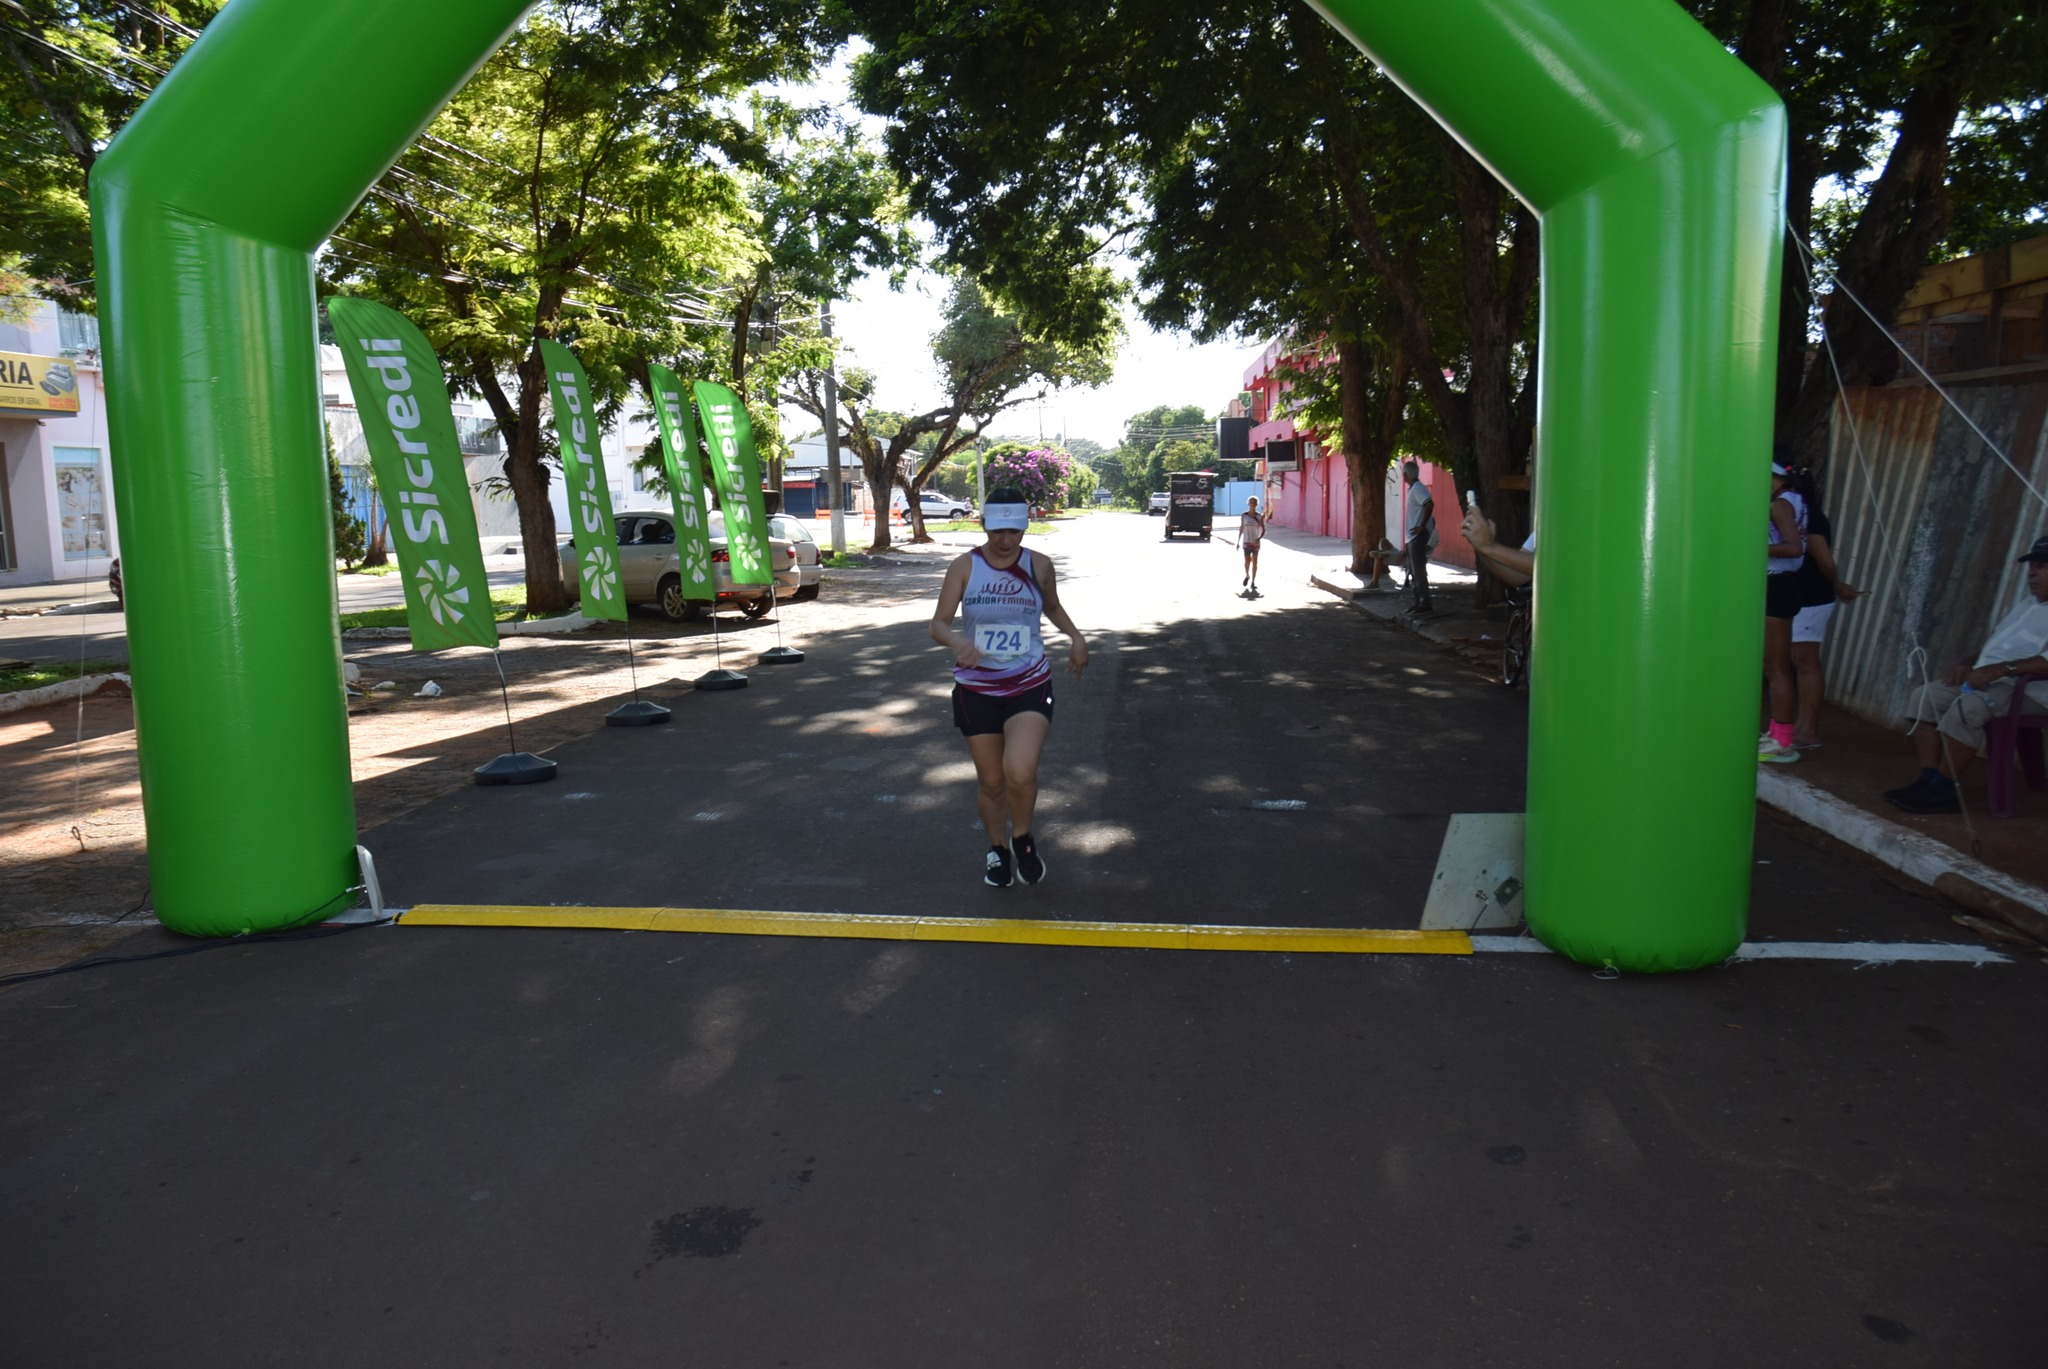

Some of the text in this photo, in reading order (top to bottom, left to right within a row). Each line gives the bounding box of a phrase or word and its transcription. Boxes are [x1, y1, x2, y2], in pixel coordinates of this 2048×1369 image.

[0, 359, 34, 385] RIA
[359, 339, 449, 544] Sicredi
[556, 372, 606, 536] Sicredi
[662, 392, 699, 530] Sicredi
[710, 404, 751, 524] Sicredi
[984, 630, 1021, 651] 724
